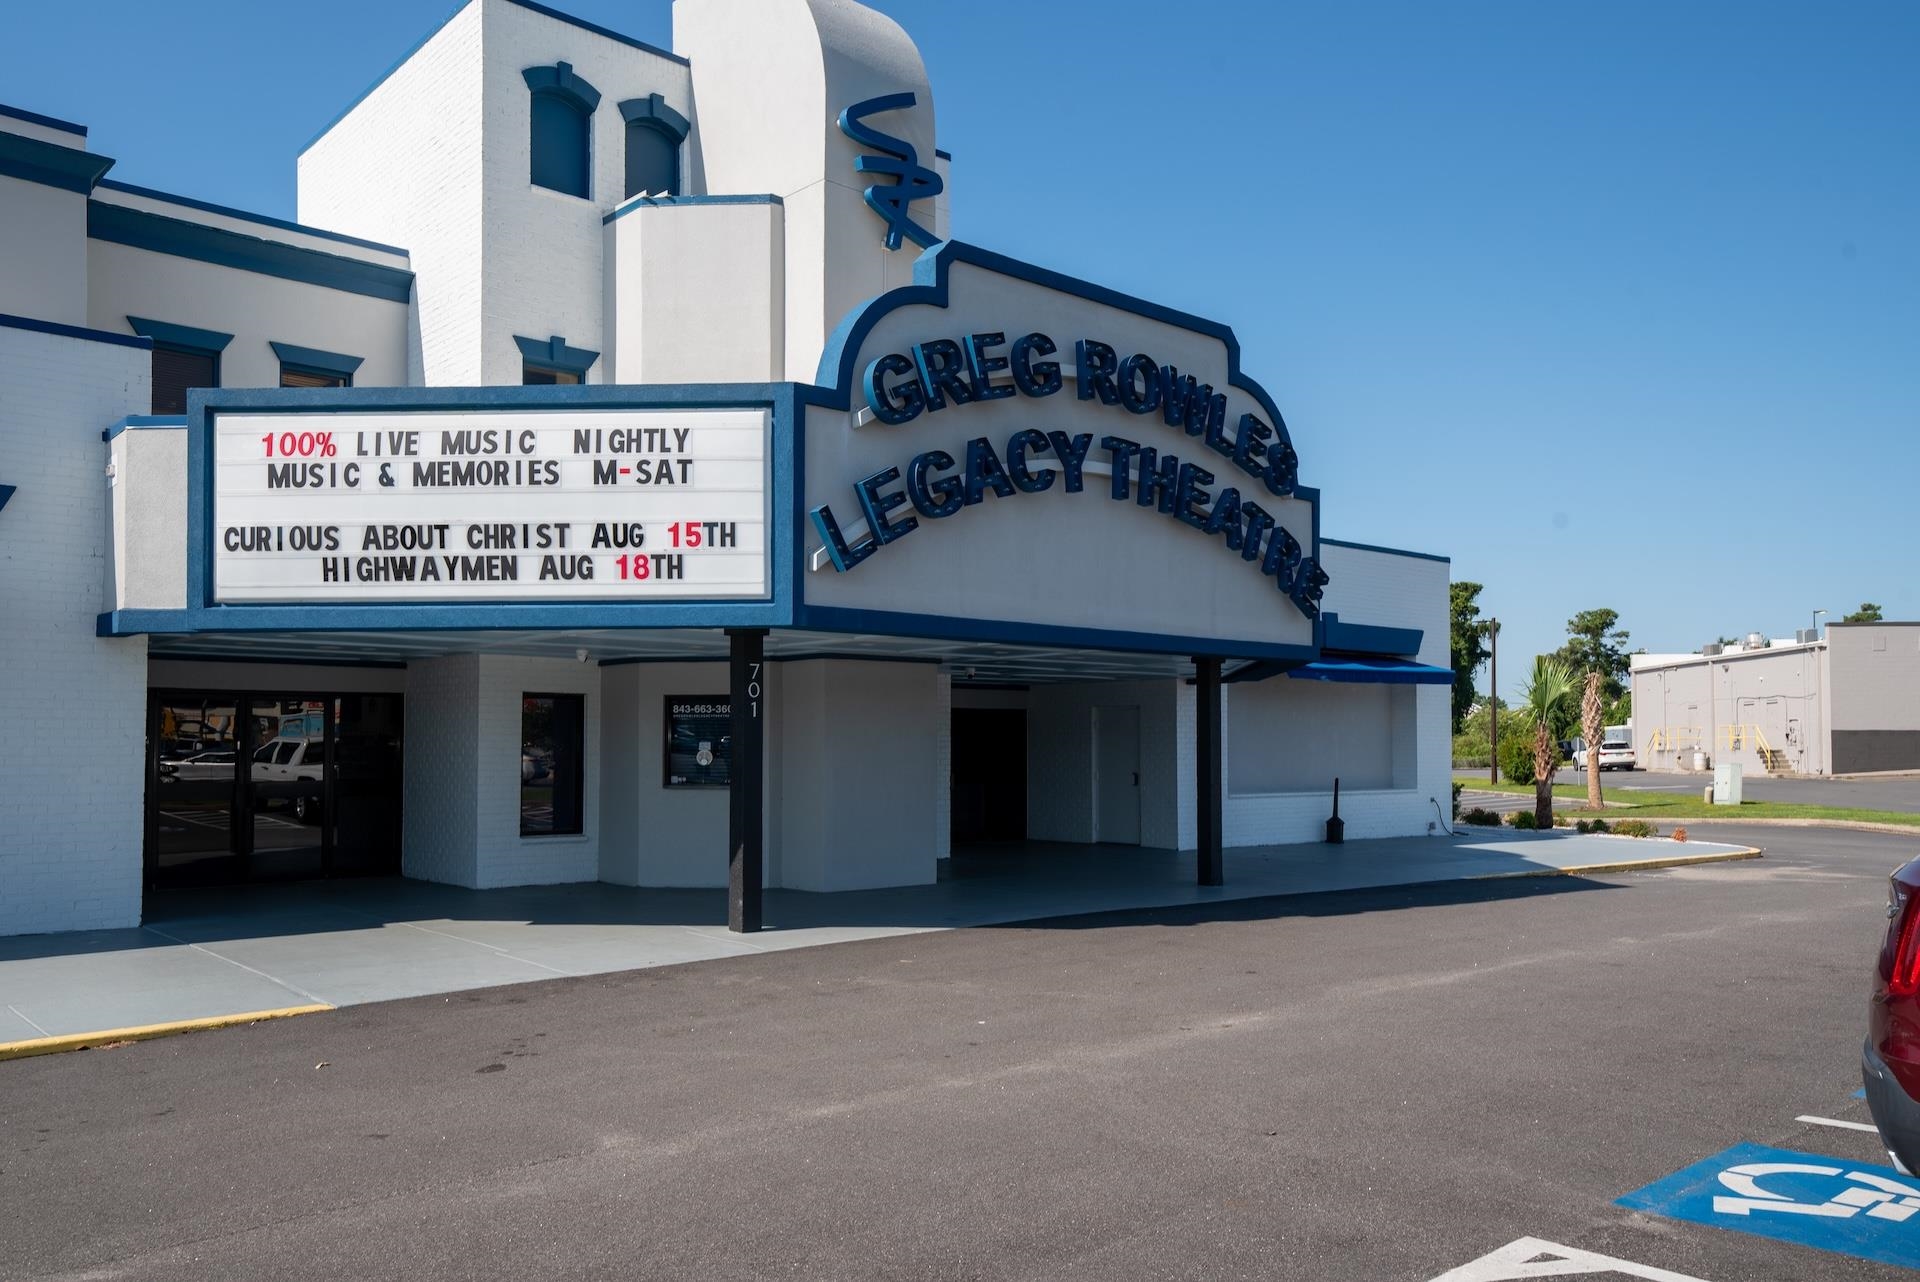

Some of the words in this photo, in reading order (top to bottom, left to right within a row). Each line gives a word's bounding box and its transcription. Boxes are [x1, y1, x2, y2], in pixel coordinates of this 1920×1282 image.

[864, 331, 1063, 425] GREG
[1075, 338, 1299, 497] ROWLES
[262, 432, 336, 456] 100%
[356, 432, 418, 456] LIVE
[442, 431, 535, 454] MUSIC
[574, 429, 689, 453] NIGHTLY
[268, 463, 359, 488] MUSIC
[379, 463, 394, 486] &
[413, 461, 559, 486] MEMORIES
[594, 459, 692, 484] M-SAT
[225, 526, 339, 551] CURIOUS
[362, 525, 449, 550] ABOUT
[467, 523, 570, 549] CHRIST
[592, 523, 644, 548] AUG
[668, 522, 735, 547] 15TH
[810, 428, 1094, 573] LEGACY
[1101, 435, 1330, 620] THEATRE
[323, 556, 517, 582] HIGHWAYMEN
[539, 555, 593, 580] AUG
[616, 554, 682, 579] 18TH
[748, 663, 760, 718] 701
